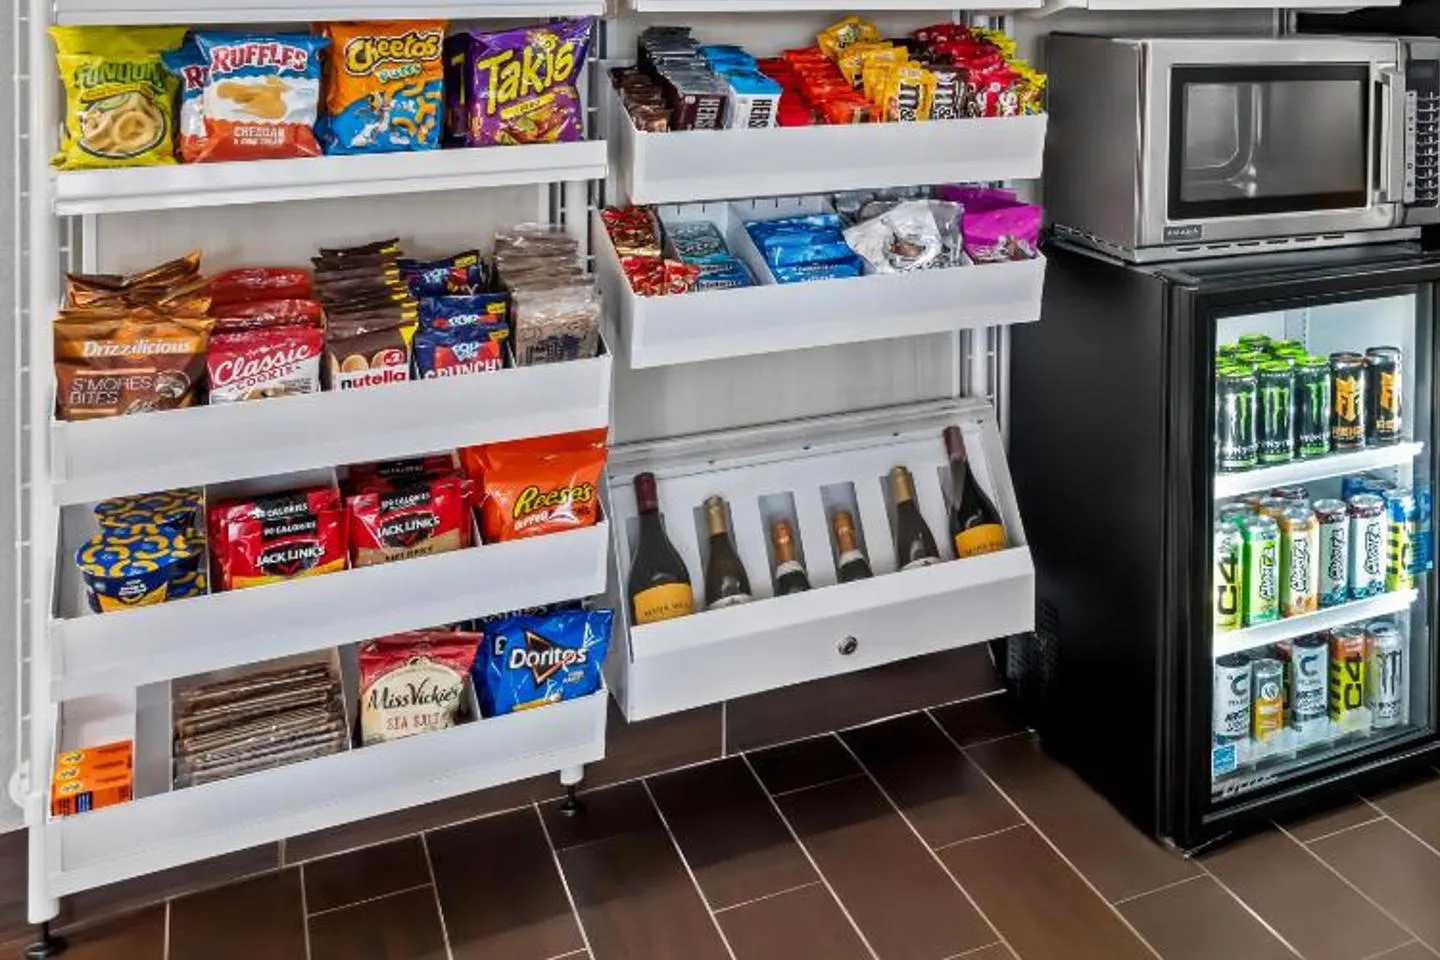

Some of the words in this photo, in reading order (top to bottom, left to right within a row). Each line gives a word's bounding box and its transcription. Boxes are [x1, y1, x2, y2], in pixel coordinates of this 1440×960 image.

[210, 43, 308, 73] RUFFLES
[346, 31, 441, 72] Cheetos
[478, 33, 574, 115] Takis
[214, 343, 312, 385] Classic
[72, 376, 154, 391] S'MORES
[341, 368, 407, 390] nutella
[69, 390, 119, 405] BITES
[275, 521, 316, 535] CALORIES
[376, 522, 405, 538] JACK
[255, 551, 287, 568] JACK
[509, 645, 587, 670] Doritos
[367, 688, 408, 711] Miss
[386, 715, 409, 731] SEA
